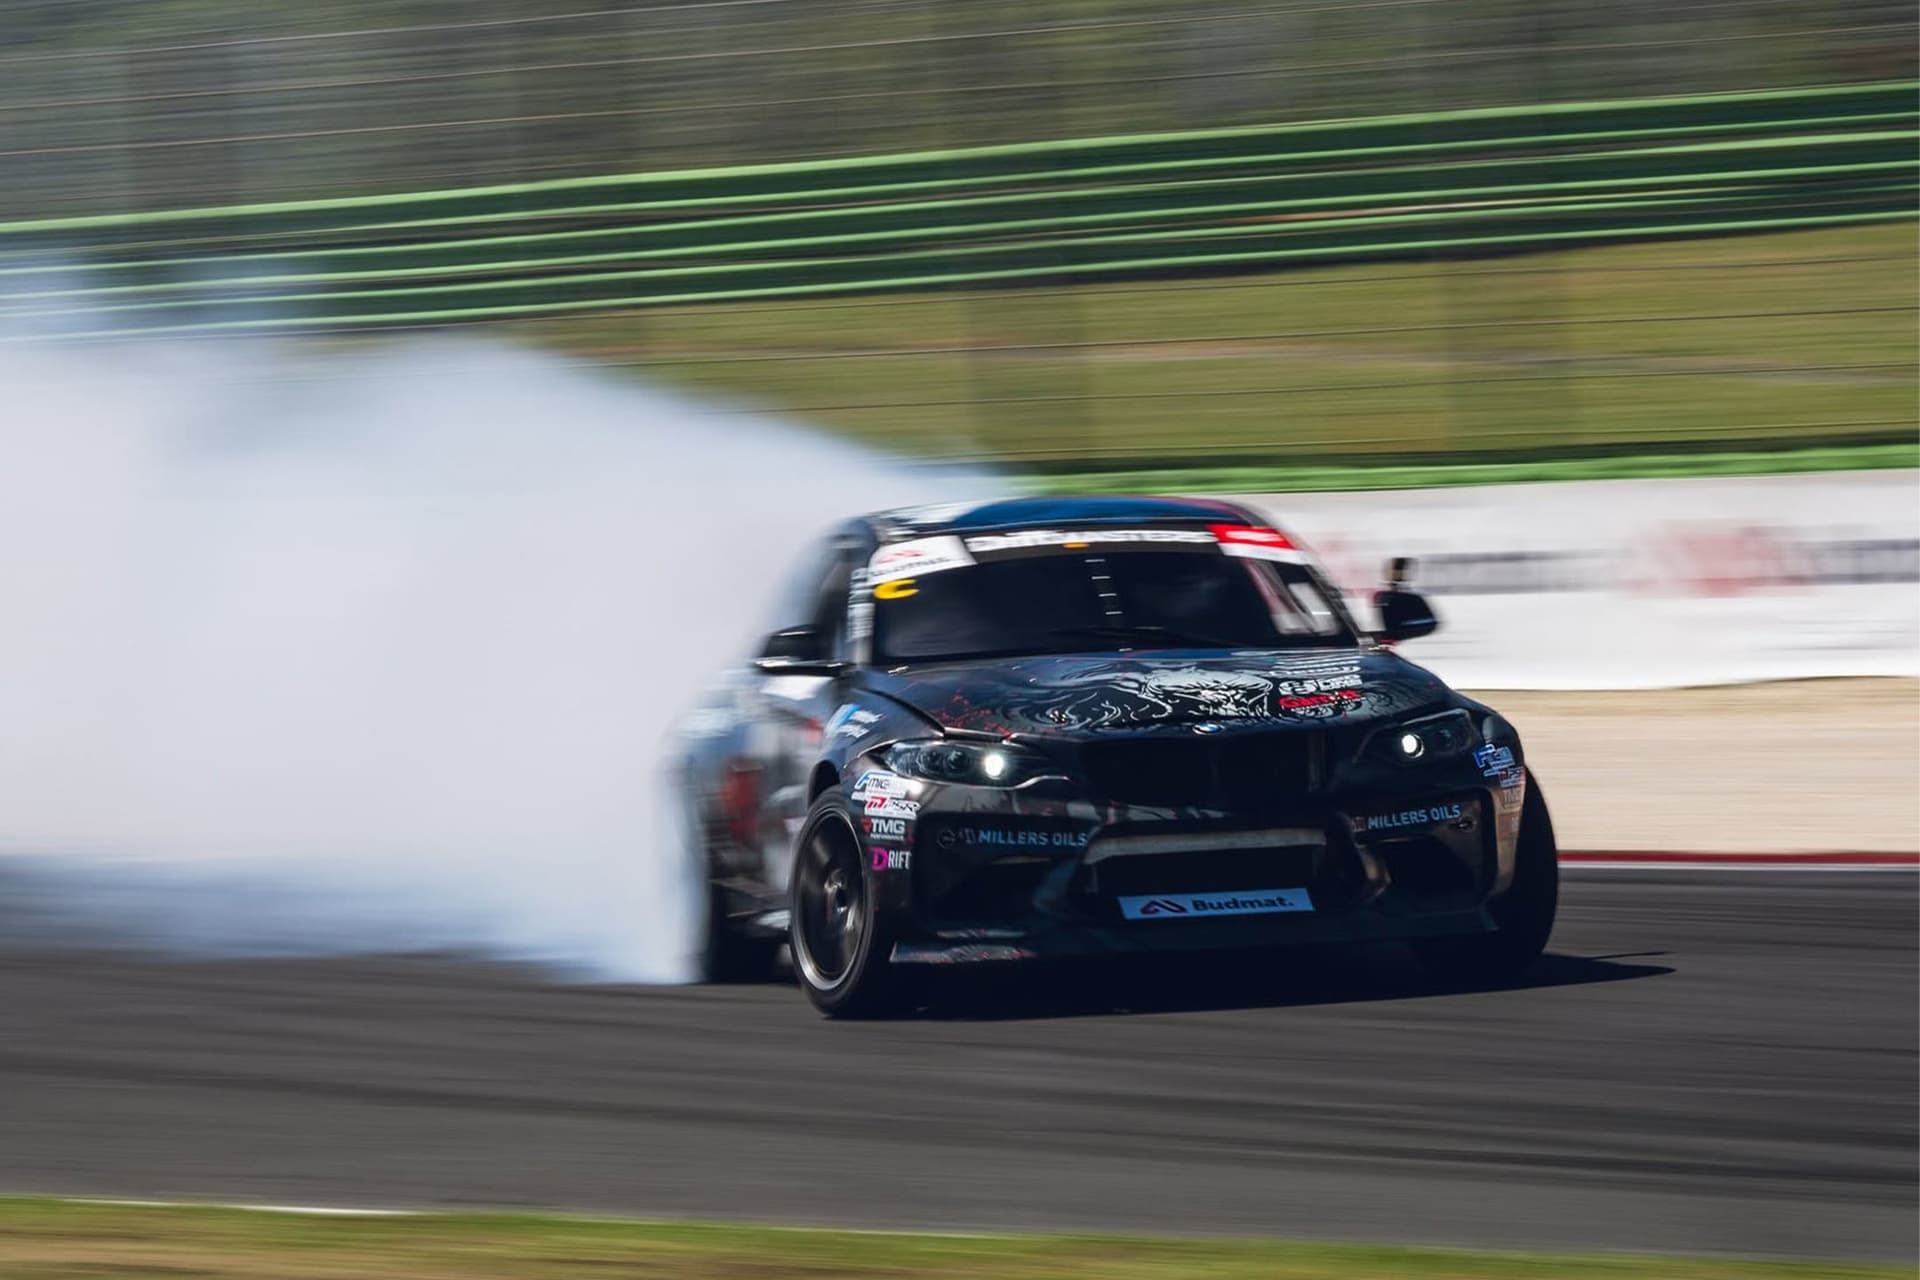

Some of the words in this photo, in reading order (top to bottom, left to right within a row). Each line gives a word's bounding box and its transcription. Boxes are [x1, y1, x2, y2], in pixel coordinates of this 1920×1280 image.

[871, 818, 905, 834] TMG
[1367, 807, 1428, 830] MILLERS
[1430, 804, 1462, 821] OILS
[977, 829, 1049, 845] MILLERS
[1052, 832, 1089, 847] OILS
[871, 847, 912, 871] DRIFT
[1191, 896, 1295, 912] Budmat.
